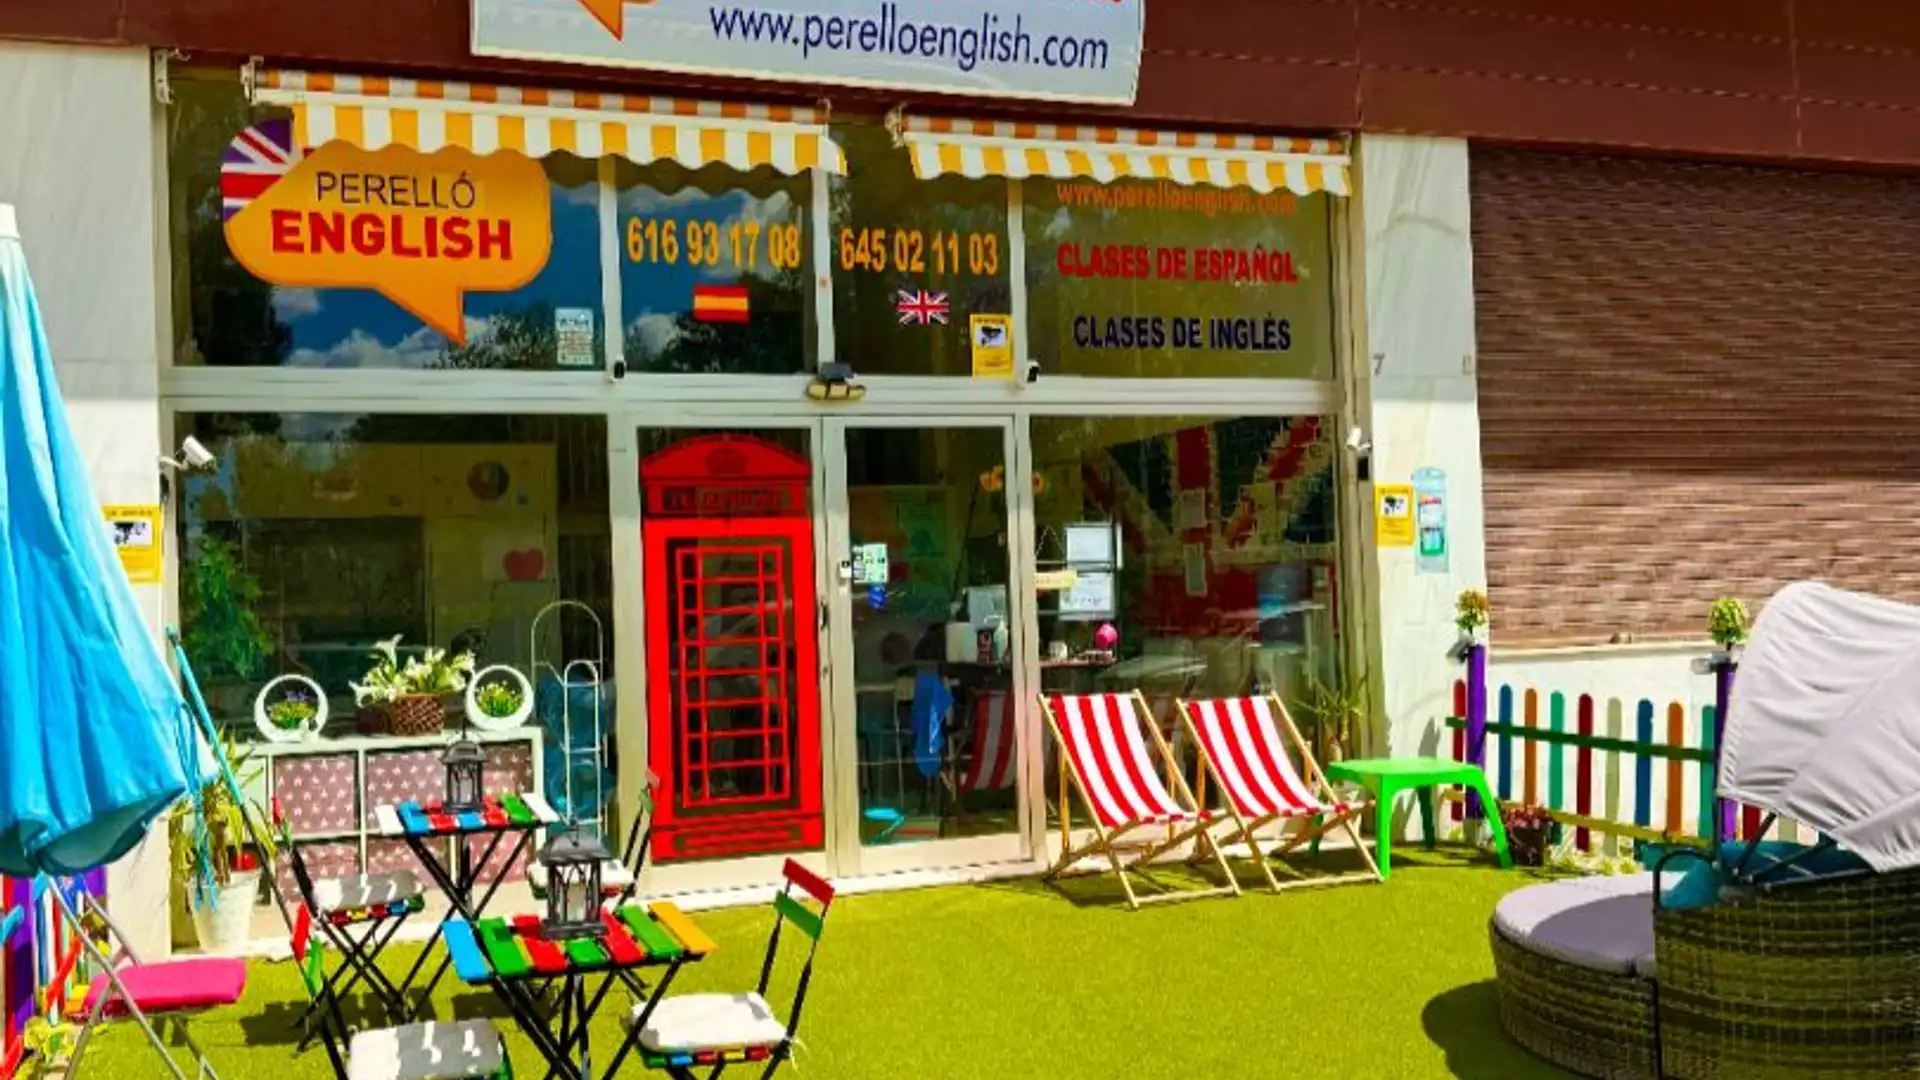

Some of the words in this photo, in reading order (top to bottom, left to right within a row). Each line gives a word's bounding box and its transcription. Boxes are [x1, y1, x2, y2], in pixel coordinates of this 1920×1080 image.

[709, 4, 1108, 71] www.perelloenglish.com
[316, 170, 476, 209] PERELLÓ
[271, 209, 512, 260] ENGLISH
[626, 216, 678, 264] 616
[686, 219, 720, 266] 93
[728, 221, 760, 268] 17
[768, 223, 799, 270] 08
[840, 227, 886, 273] 645
[895, 230, 925, 273] 02
[932, 231, 959, 275] 11
[969, 233, 998, 276] 03
[1056, 241, 1150, 278] CLASES
[1157, 246, 1189, 280] DE
[1194, 243, 1298, 285] ESPAÑOL
[1074, 313, 1166, 349] CLASES
[1173, 317, 1203, 350] DE
